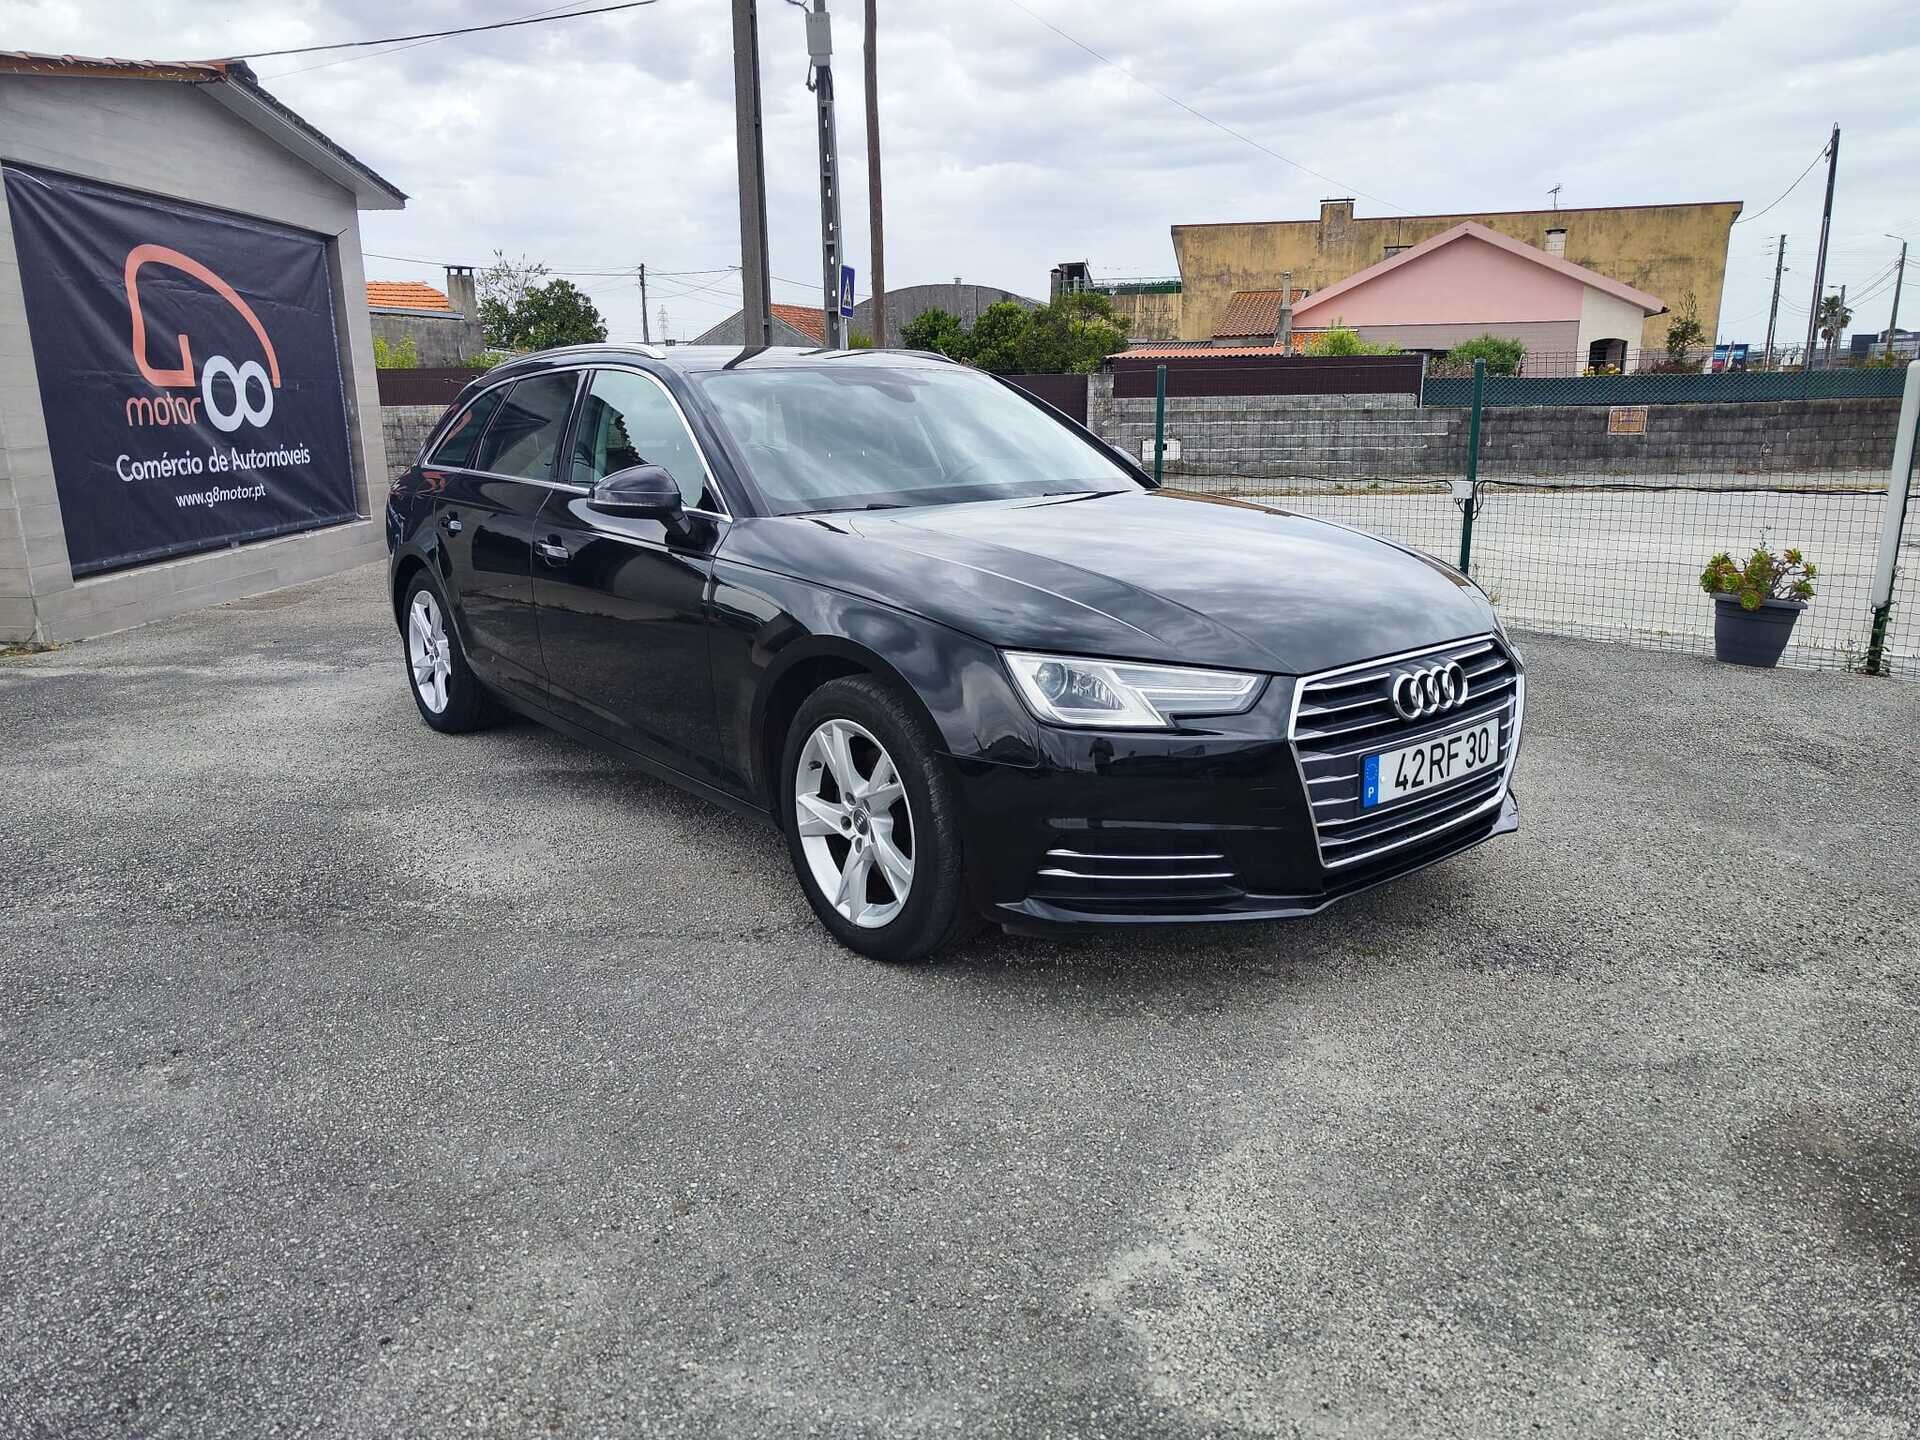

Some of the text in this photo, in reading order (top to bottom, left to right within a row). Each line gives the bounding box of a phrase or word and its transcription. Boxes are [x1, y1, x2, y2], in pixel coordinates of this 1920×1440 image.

[115, 443, 311, 483] Comércio de Automóveis
[175, 484, 266, 508] www.g8motor.pt
[1367, 787, 1375, 799] P
